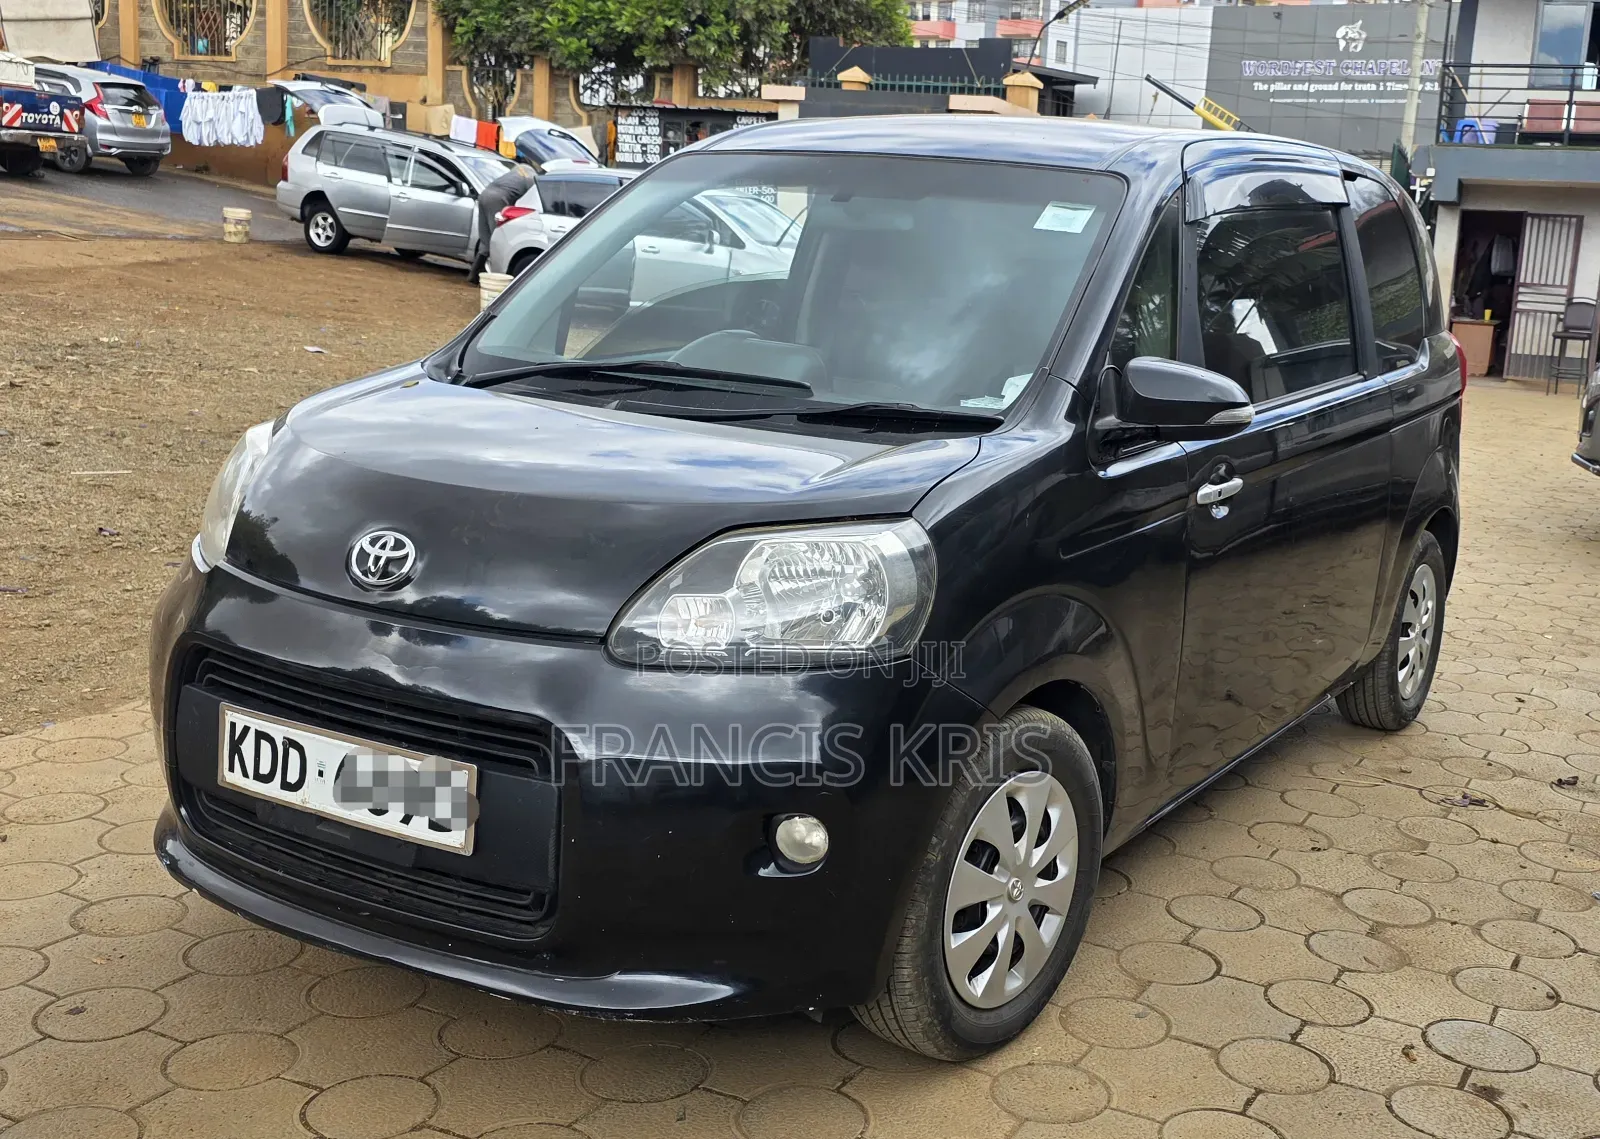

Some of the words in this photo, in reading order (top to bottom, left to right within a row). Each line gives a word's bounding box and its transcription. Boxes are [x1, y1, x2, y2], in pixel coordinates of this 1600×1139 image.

[1241, 60, 1337, 76] WORDFEST
[1340, 59, 1411, 76] CHAPEL
[1253, 82, 1269, 91] The
[1269, 82, 1292, 92] pillar
[1292, 82, 1309, 91] and
[1309, 82, 1339, 92] ground
[1340, 82, 1353, 91] for
[1354, 82, 1377, 91] truth
[21, 113, 61, 125] TOYOTA
[228, 721, 308, 793] KDD
